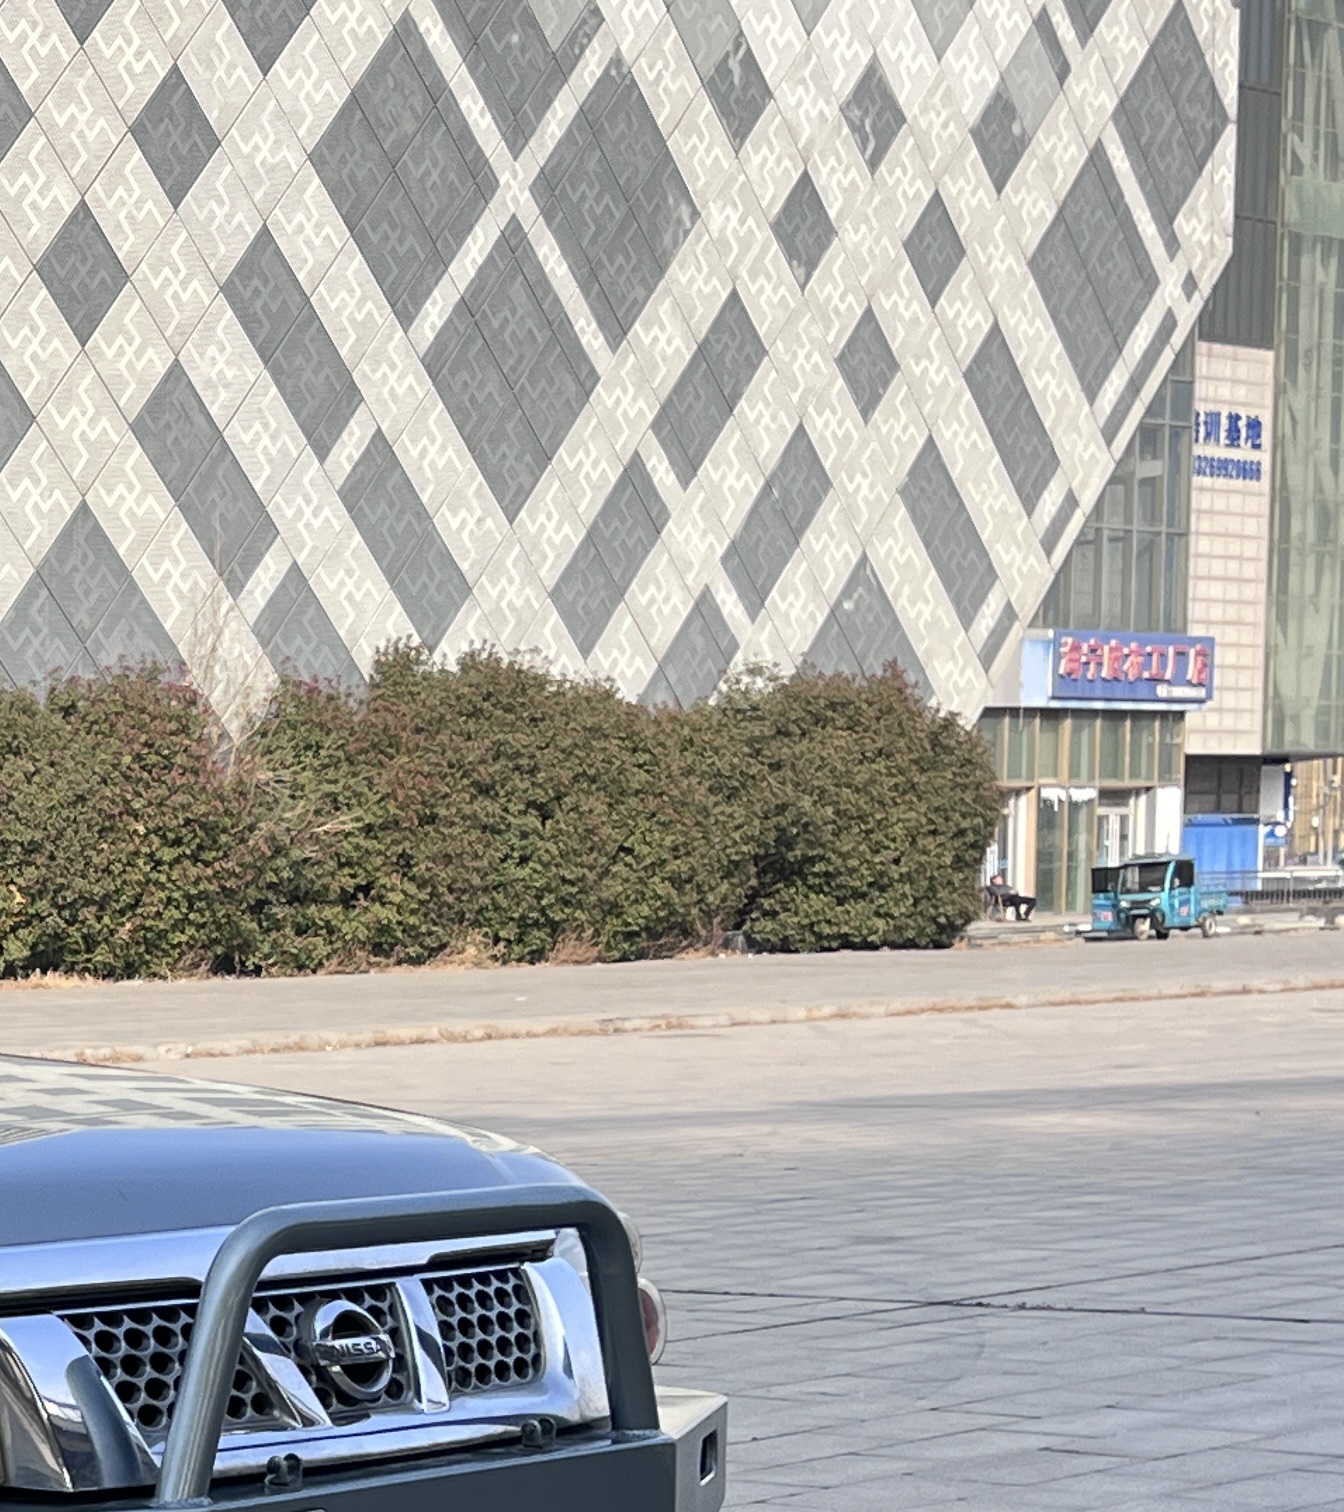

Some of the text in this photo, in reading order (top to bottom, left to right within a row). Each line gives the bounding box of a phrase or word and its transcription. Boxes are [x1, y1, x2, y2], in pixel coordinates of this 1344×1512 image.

[1058, 636, 1209, 684] 海宁皮衣工厂店
